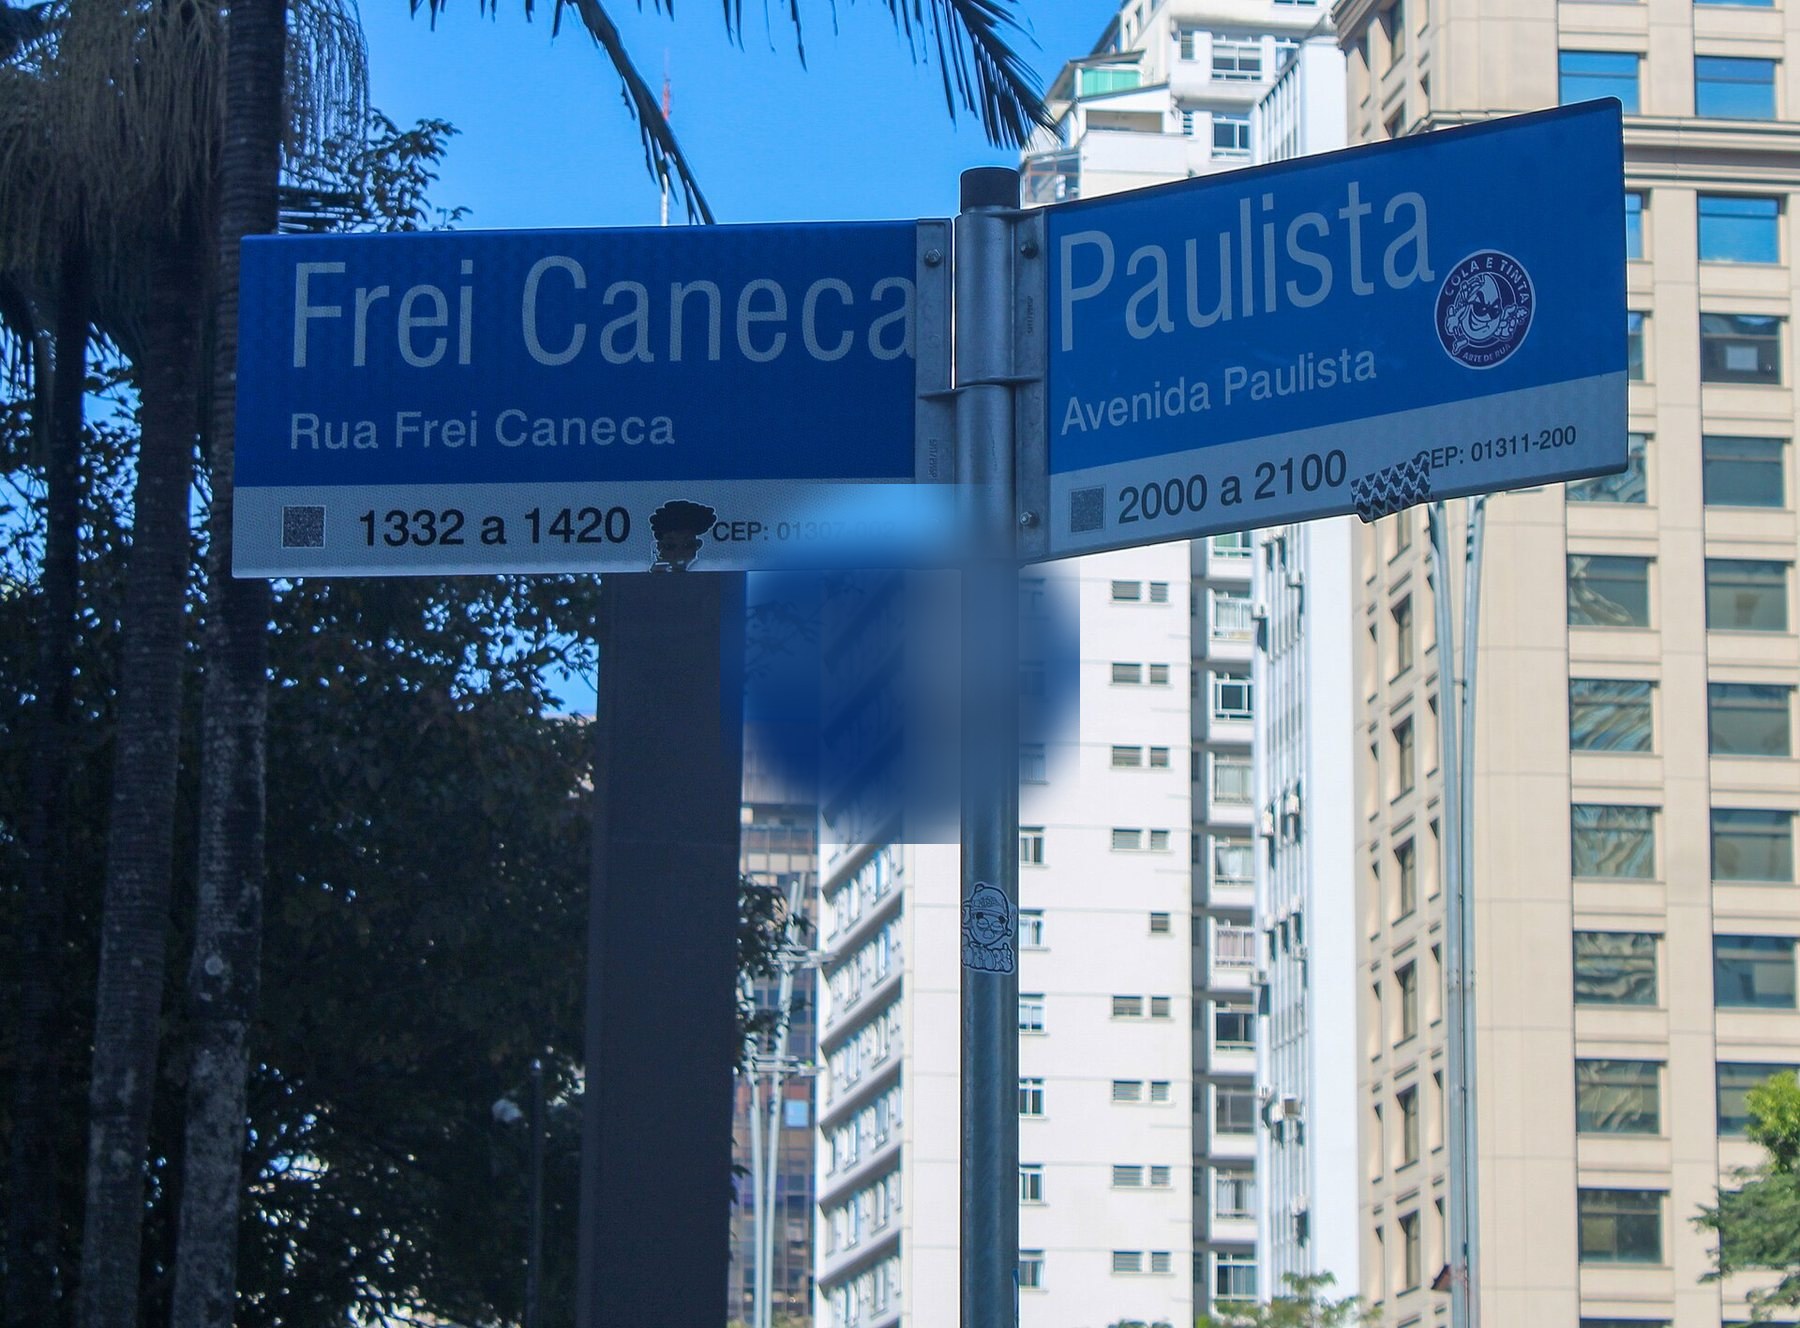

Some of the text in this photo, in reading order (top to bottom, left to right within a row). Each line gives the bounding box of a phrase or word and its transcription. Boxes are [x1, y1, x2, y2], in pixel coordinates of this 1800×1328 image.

[1060, 181, 1435, 352] Paulista
[1445, 257, 1529, 303] COLA E TINTA
[293, 255, 916, 368] Frei Caneca
[1462, 352, 1482, 362] ARTE
[1483, 353, 1493, 361] DE
[1061, 350, 1377, 435] Avenida Paulista
[291, 409, 675, 449] Rua Frei Caneca
[1471, 425, 1577, 462] 01311-200
[1118, 449, 1348, 524] 2000 a 2100
[359, 506, 631, 547] 1332 a 1420
[712, 521, 768, 541] CEP:
